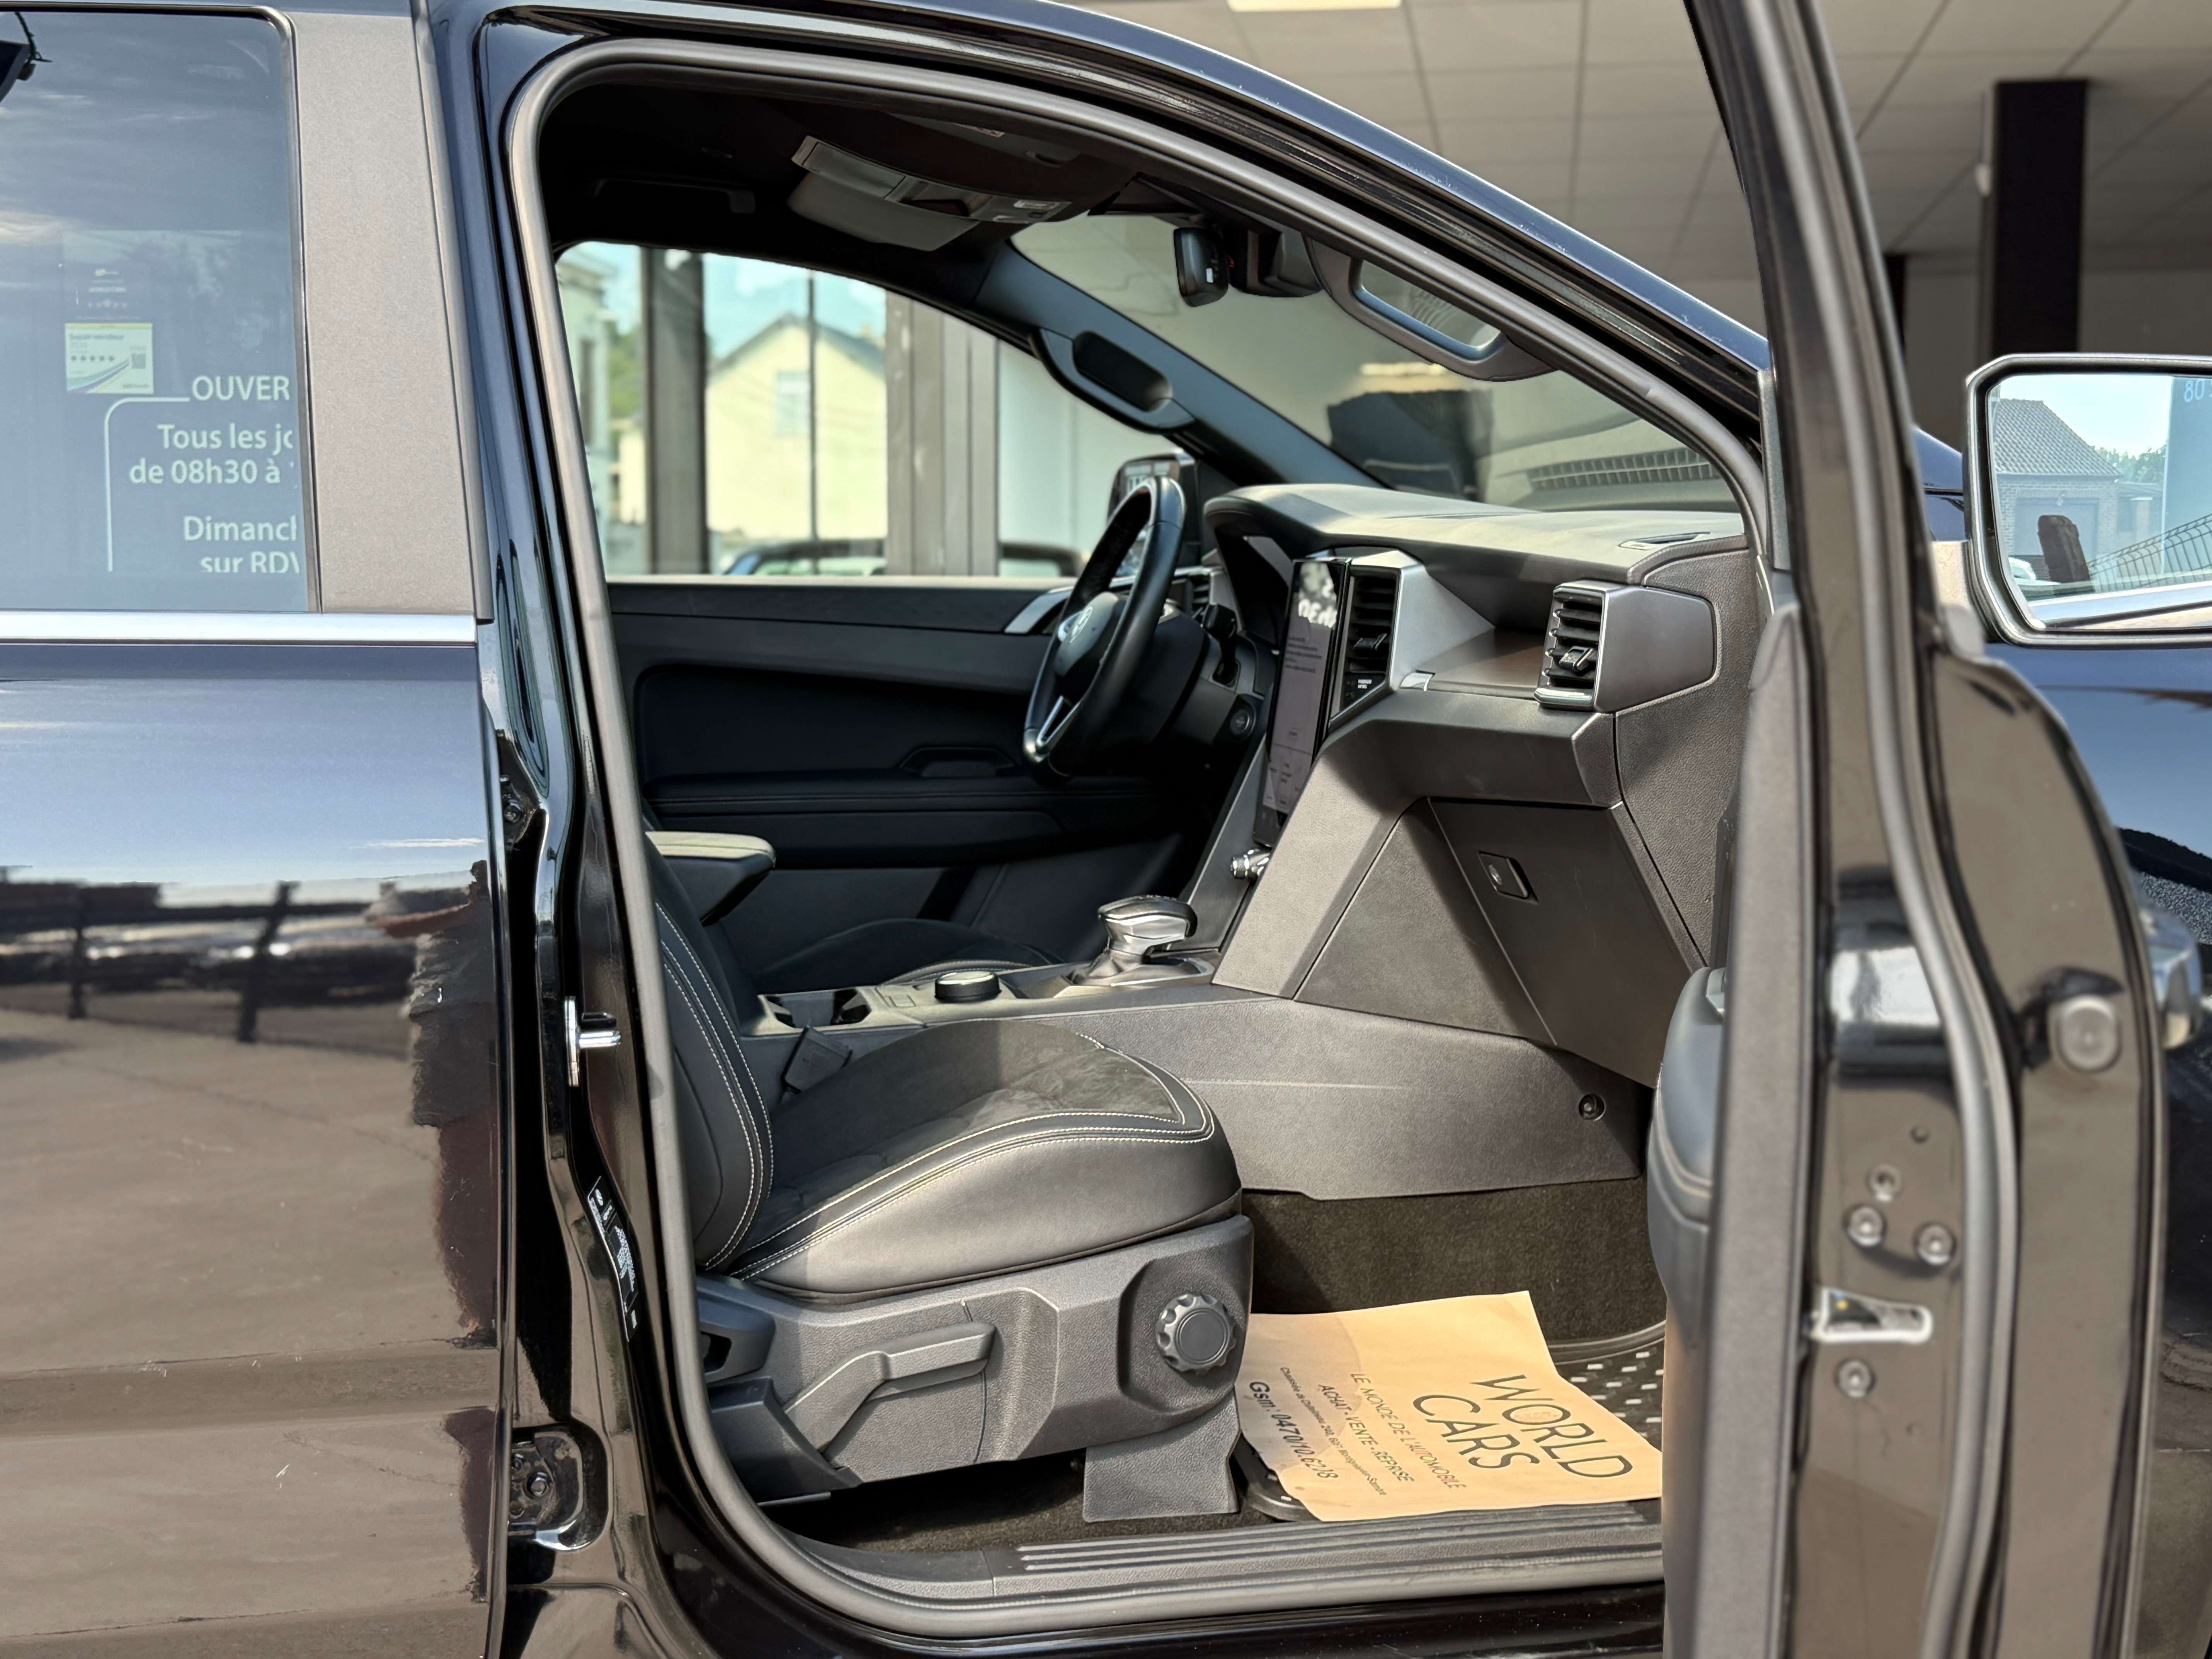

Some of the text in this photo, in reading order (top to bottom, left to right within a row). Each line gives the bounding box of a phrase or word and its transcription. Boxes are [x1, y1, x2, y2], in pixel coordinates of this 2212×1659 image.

[157, 424, 222, 449] Tous
[230, 422, 267, 449] les
[129, 458, 280, 484] de 08h30 à
[199, 556, 243, 573] sur
[1351, 1374, 1371, 1384] LE
[1360, 1388, 1399, 1419] MONDE
[1318, 1384, 1415, 1482] ACHAT VENTE REPRISE
[1388, 1422, 1411, 1435] DE
[1413, 1395, 1540, 1469] CARS
[1470, 1374, 1633, 1477] WORLD
